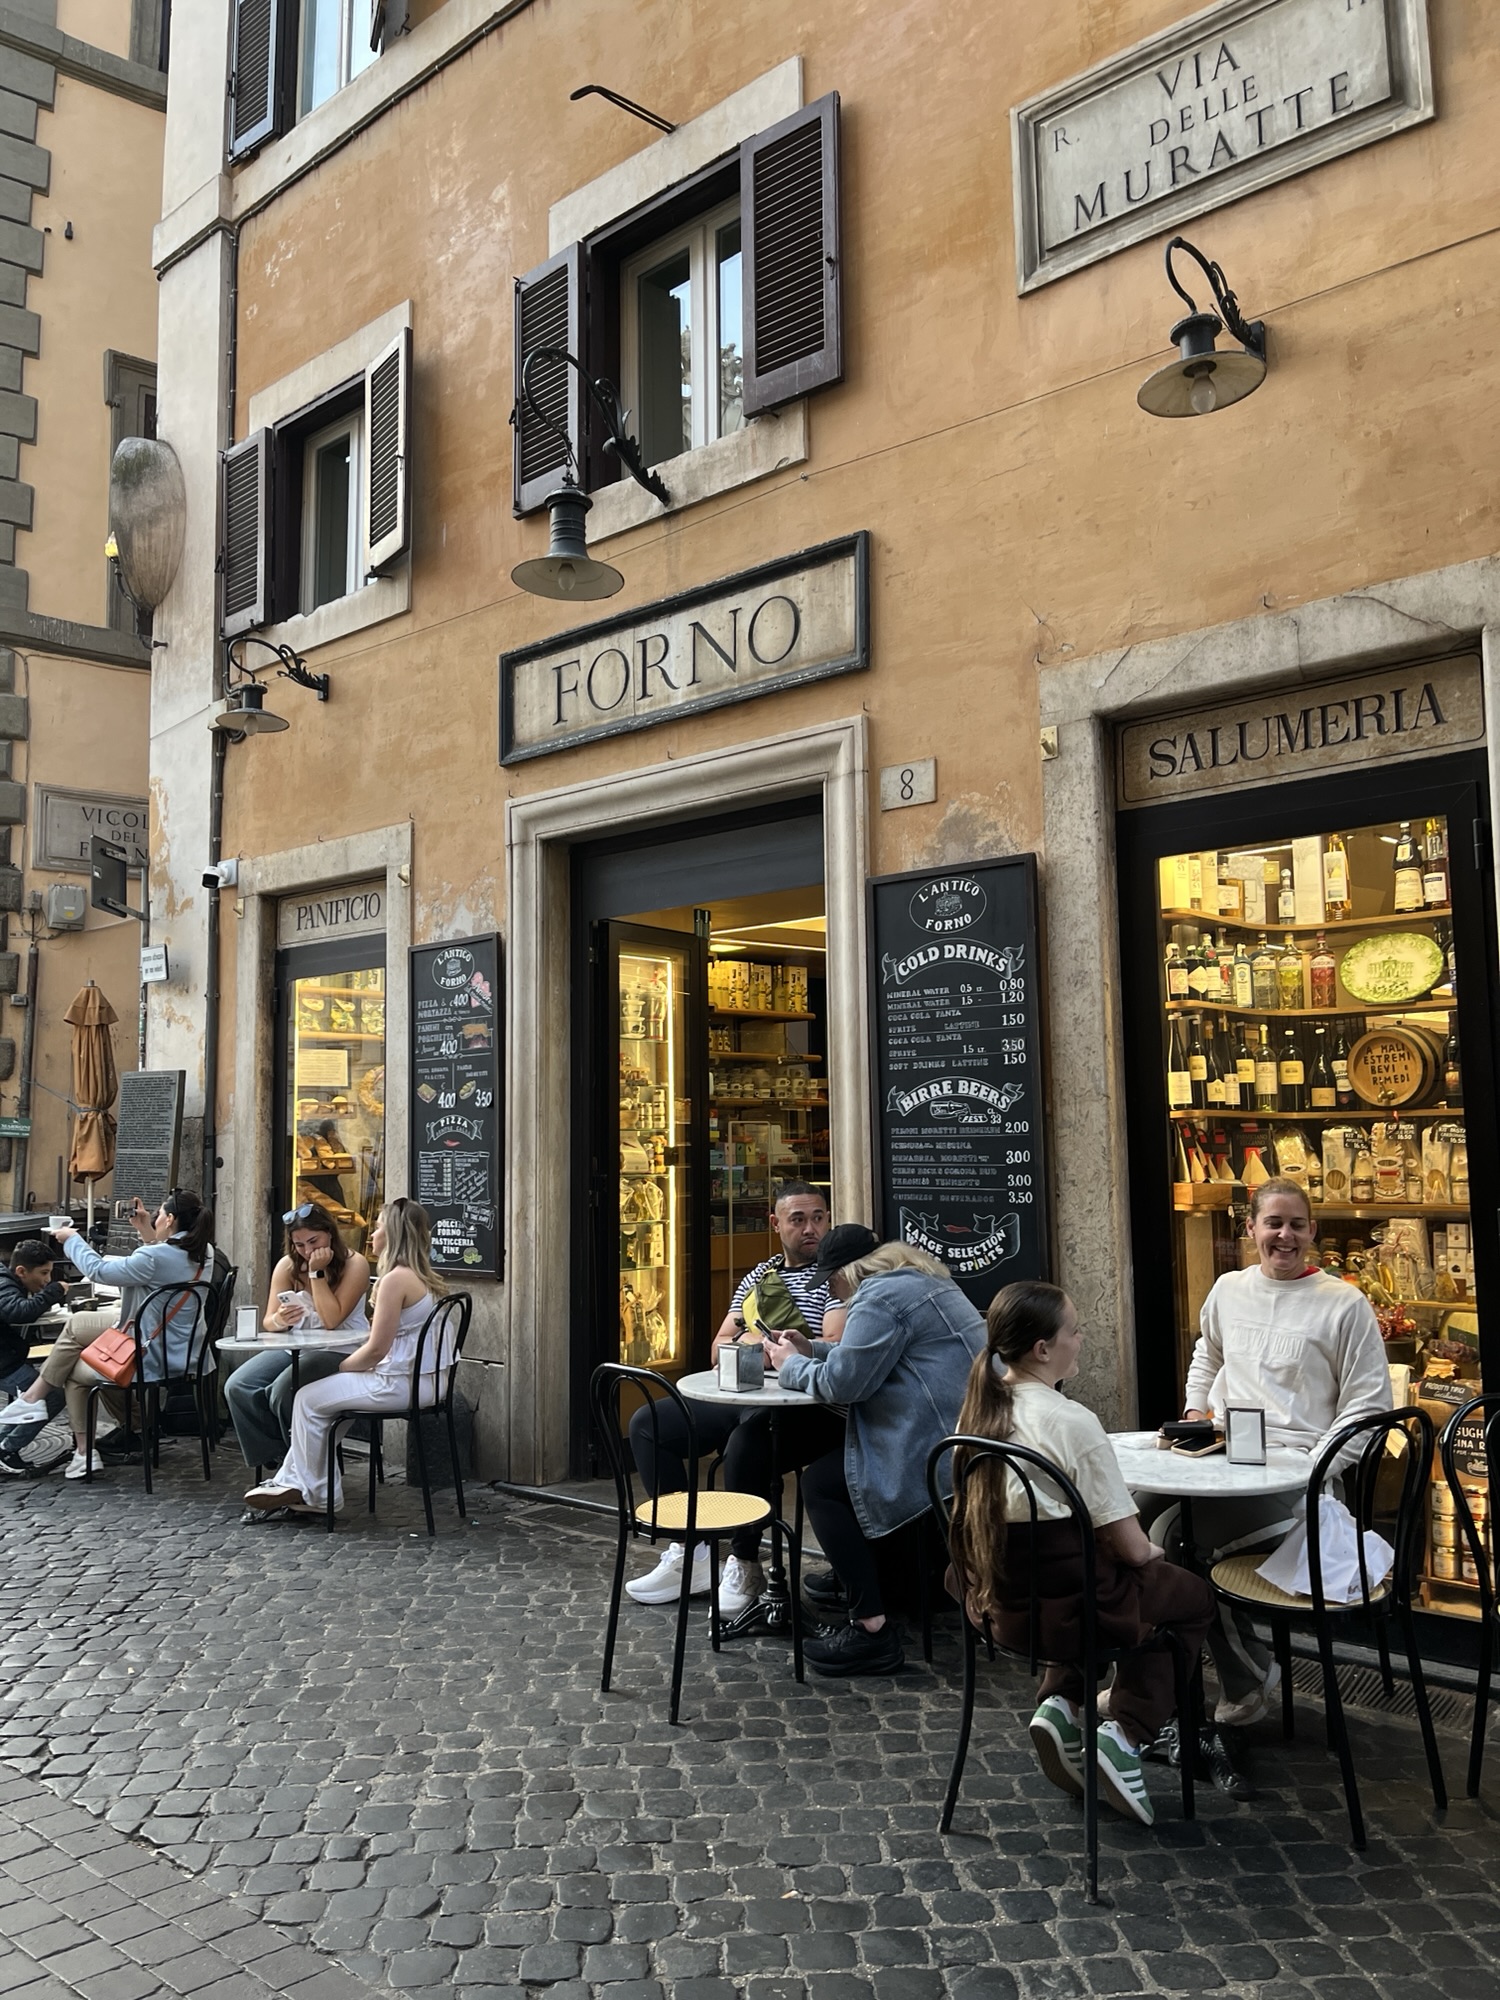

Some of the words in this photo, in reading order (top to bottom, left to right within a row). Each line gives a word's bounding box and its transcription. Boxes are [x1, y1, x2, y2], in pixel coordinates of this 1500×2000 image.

[1155, 41, 1241, 100] VIA
[1148, 75, 1259, 147] DELLE
[1053, 126, 1081, 153] R.
[1073, 70, 1355, 231] MURATTE
[551, 595, 801, 726] FORNO
[1150, 682, 1448, 780] SALUMERIA
[901, 769, 914, 800] 8
[111, 830, 140, 843] DEL
[918, 880, 980, 903] L'ANTICO
[296, 892, 381, 932] PANIFICIO
[925, 913, 972, 931] FORNO
[437, 949, 472, 965] L'ANTICO
[898, 946, 940, 976] COLD
[943, 944, 1009, 972] DRINKS
[440, 973, 467, 987] FORNO
[886, 989, 921, 999] MINERAL
[923, 987, 950, 995] WATER
[418, 999, 438, 1009] PIZZA
[887, 1013, 908, 1022] COCA
[910, 1012, 931, 1020] COLA
[1366, 1046, 1373, 1054] A
[1381, 1043, 1405, 1053] MALI
[913, 1060, 945, 1069] DRINKS
[1363, 1051, 1410, 1065] ESTREMI
[1370, 1064, 1395, 1074] BEVI
[1372, 1073, 1410, 1085] RIMEDI
[900, 1079, 953, 1111] BIRRE
[957, 1079, 1011, 1110] BEERS
[440, 1116, 467, 1128] PIZZA
[990, 1114, 1002, 1124] 33
[437, 1220, 458, 1228] DOLCI
[437, 1228, 461, 1236] FORNO
[431, 1237, 475, 1246] PASTICCERIA
[905, 1221, 944, 1255] LARGE
[947, 1229, 1006, 1258] SELECTION
[442, 1246, 460, 1254] FINE
